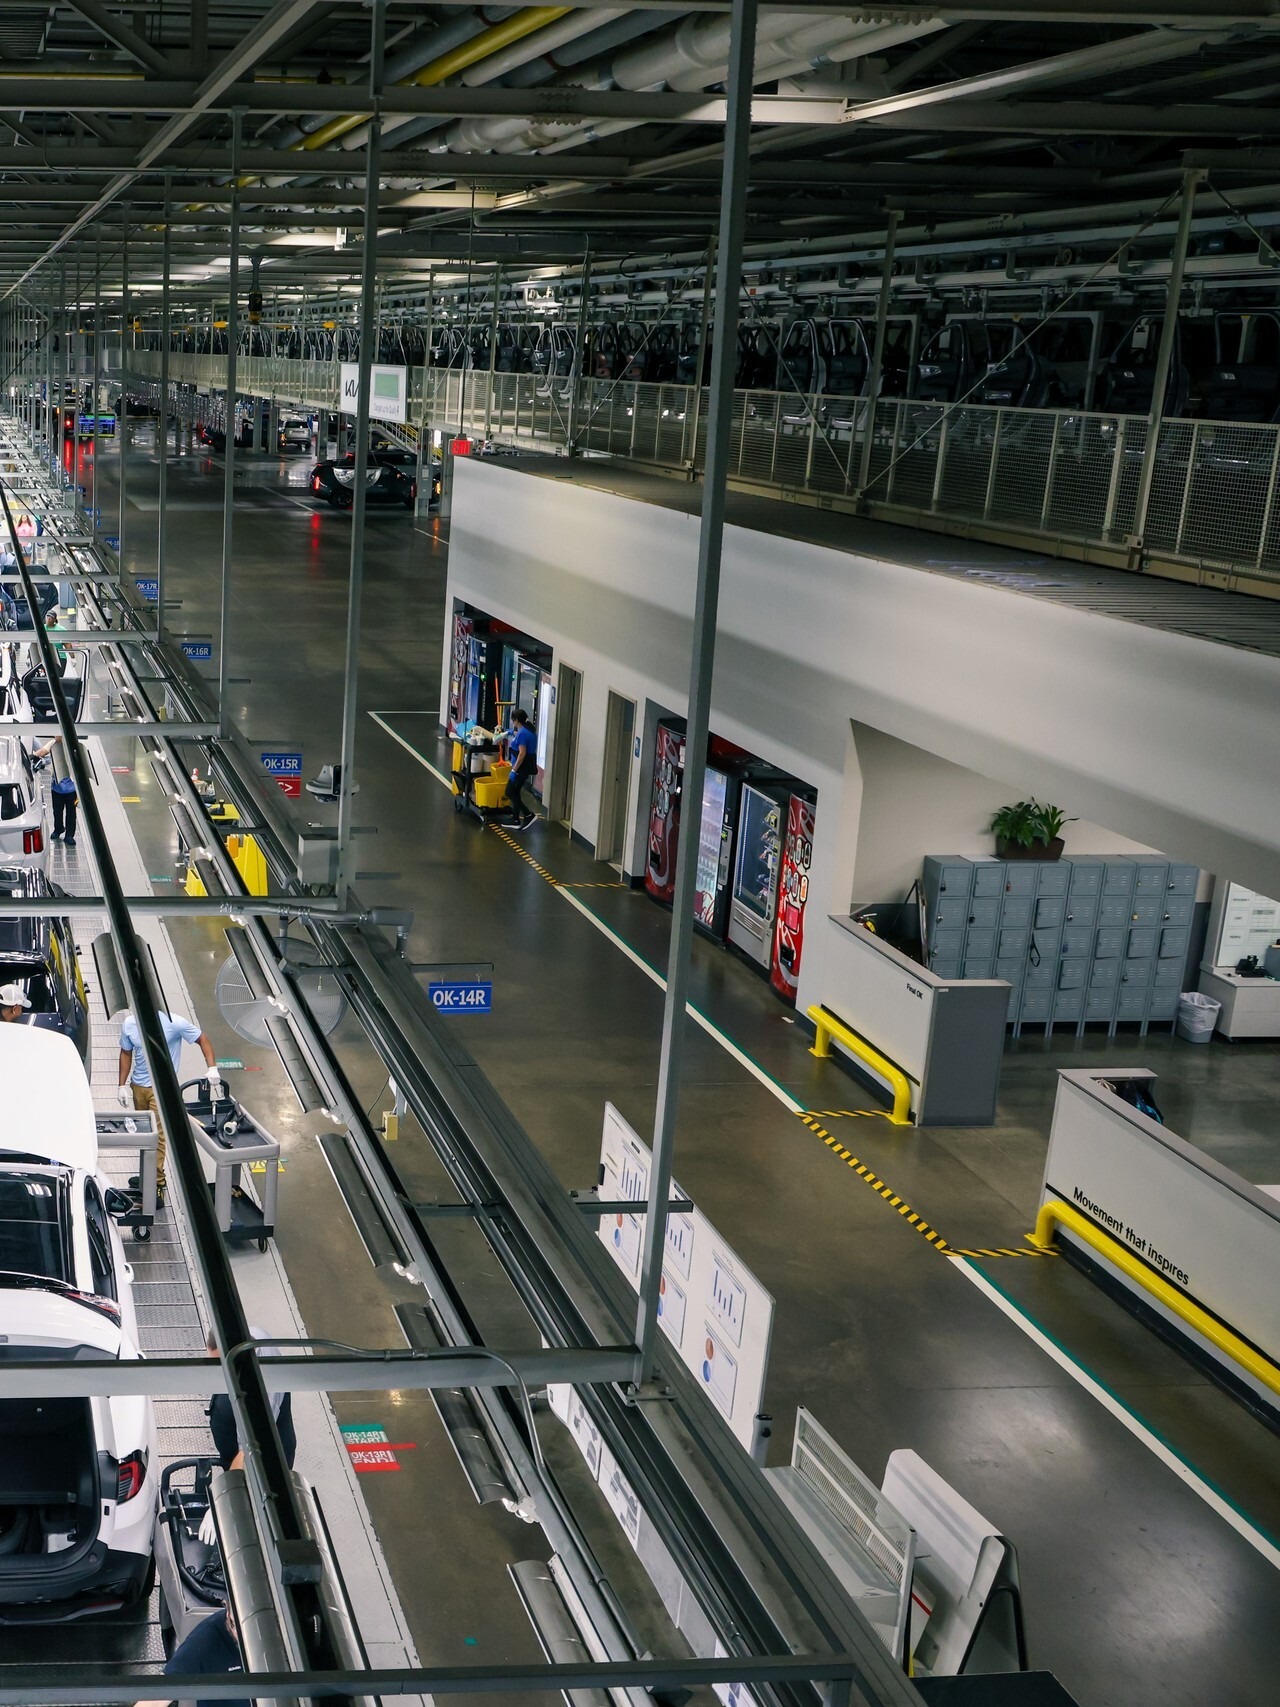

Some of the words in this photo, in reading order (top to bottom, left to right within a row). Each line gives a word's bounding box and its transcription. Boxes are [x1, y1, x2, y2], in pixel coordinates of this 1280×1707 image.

[263, 758, 299, 769] OK-15R
[432, 989, 486, 1006] OK-14R
[1073, 1186, 1124, 1234] Movement
[1125, 1226, 1147, 1252] that
[1148, 1243, 1190, 1285] inspires
[344, 1430, 381, 1439] OK-14R
[351, 1450, 388, 1459] OK-13R
